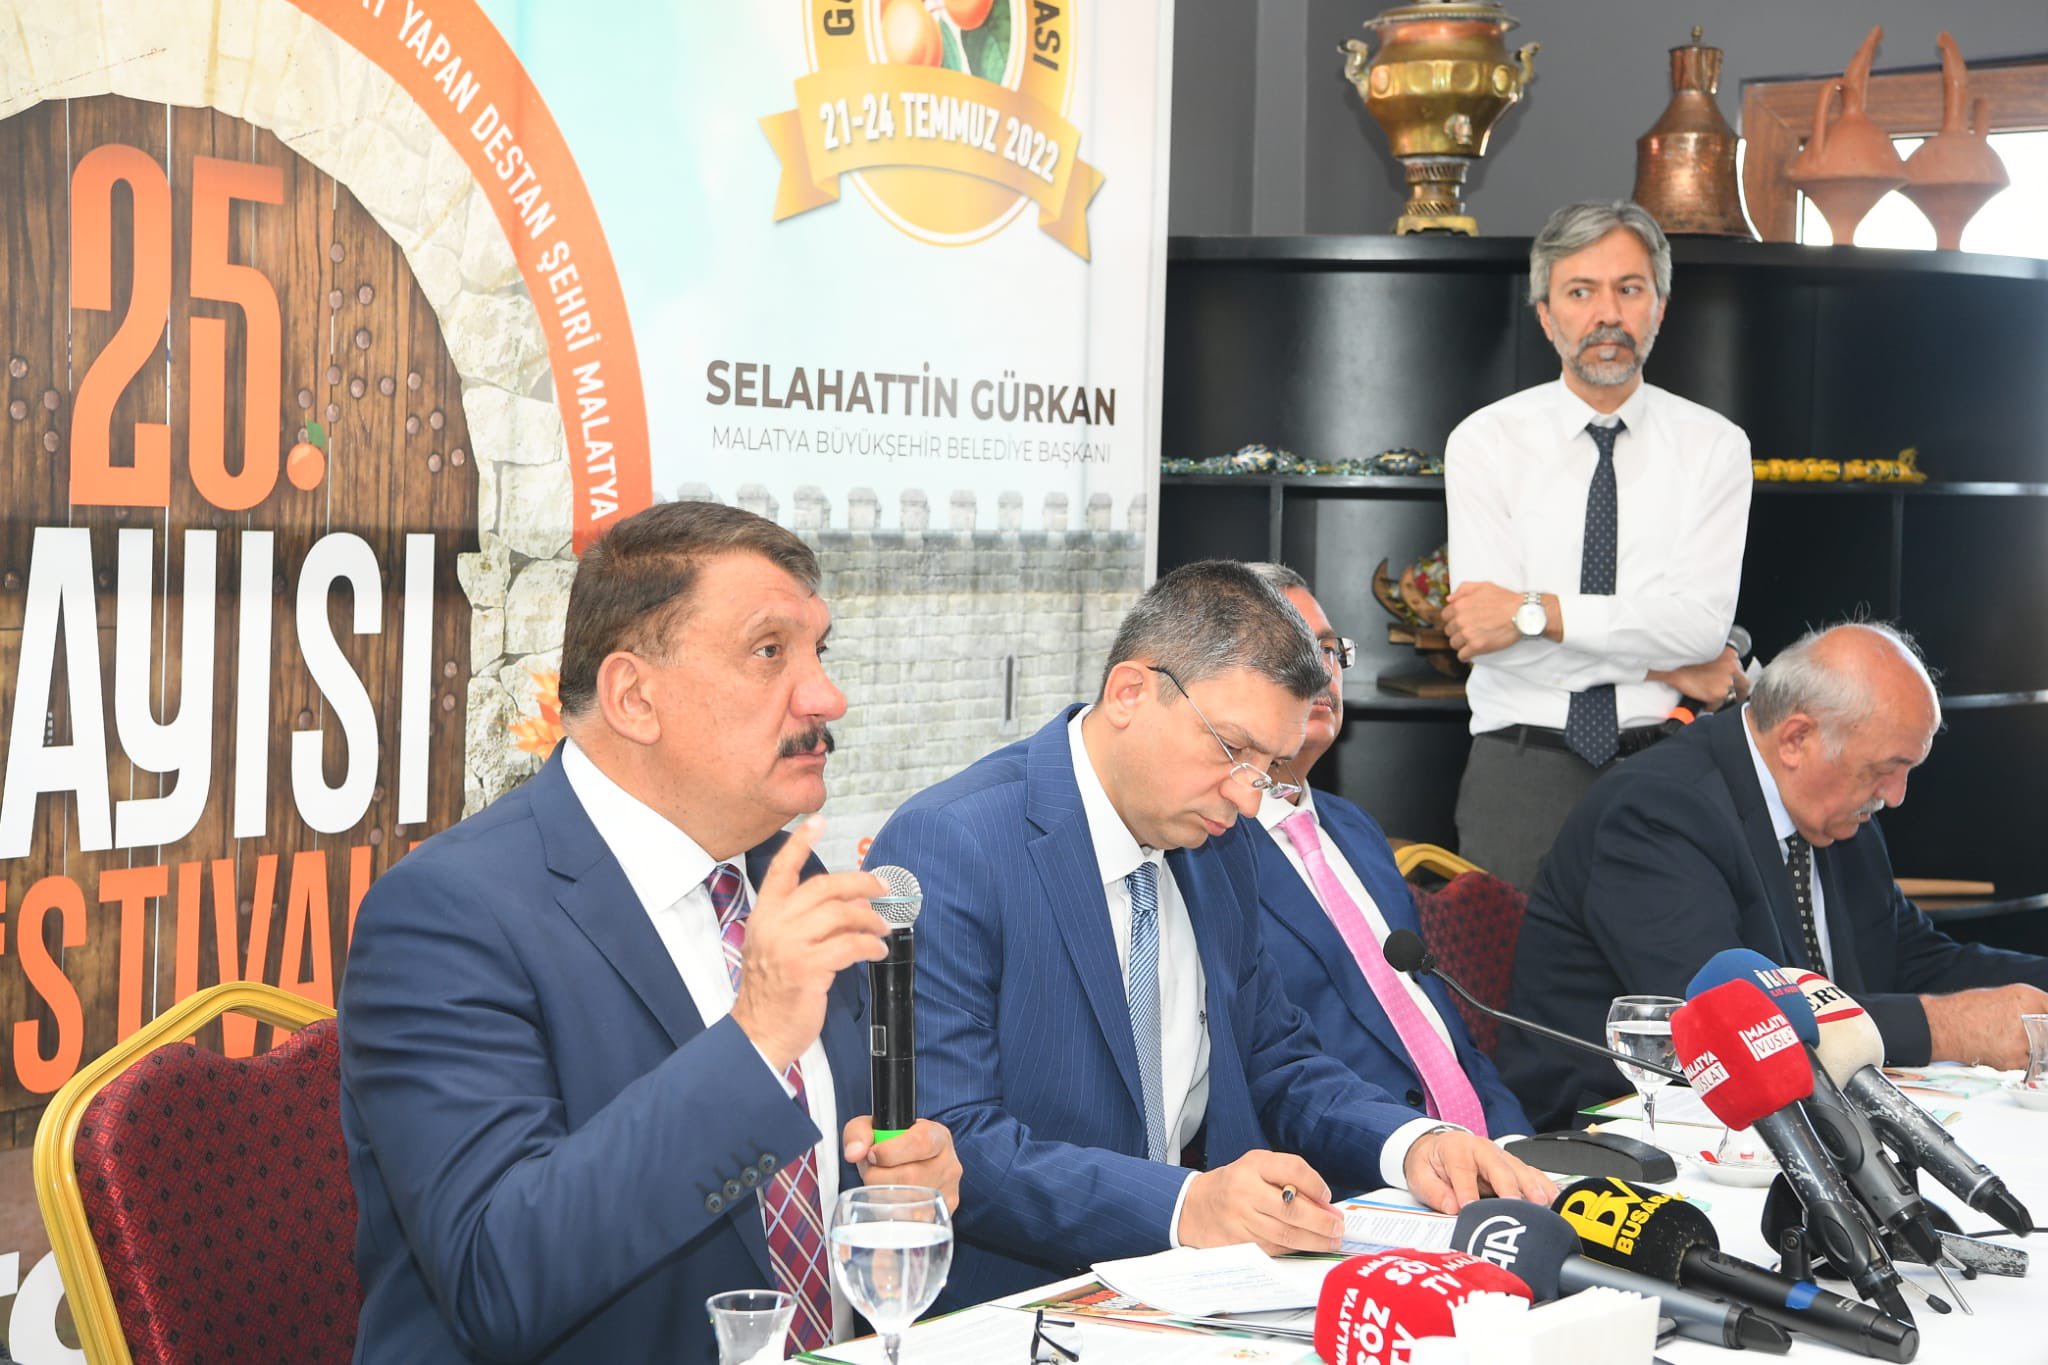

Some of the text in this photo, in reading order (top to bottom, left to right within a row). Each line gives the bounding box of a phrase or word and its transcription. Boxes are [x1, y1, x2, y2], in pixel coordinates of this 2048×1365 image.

[819, 92, 1060, 184] 21-24 TEMMUZ 2022
[398, 0, 619, 521] YAPAN DESTAN ŞEHRİ MALATYA
[706, 359, 1116, 427] SELAHATTİN GÜRKAN
[712, 425, 1111, 469] MALATYA BÜYÜKŞEHİR BELEDİYE BAŞKANI
[1420, 1272, 1462, 1295] TV
